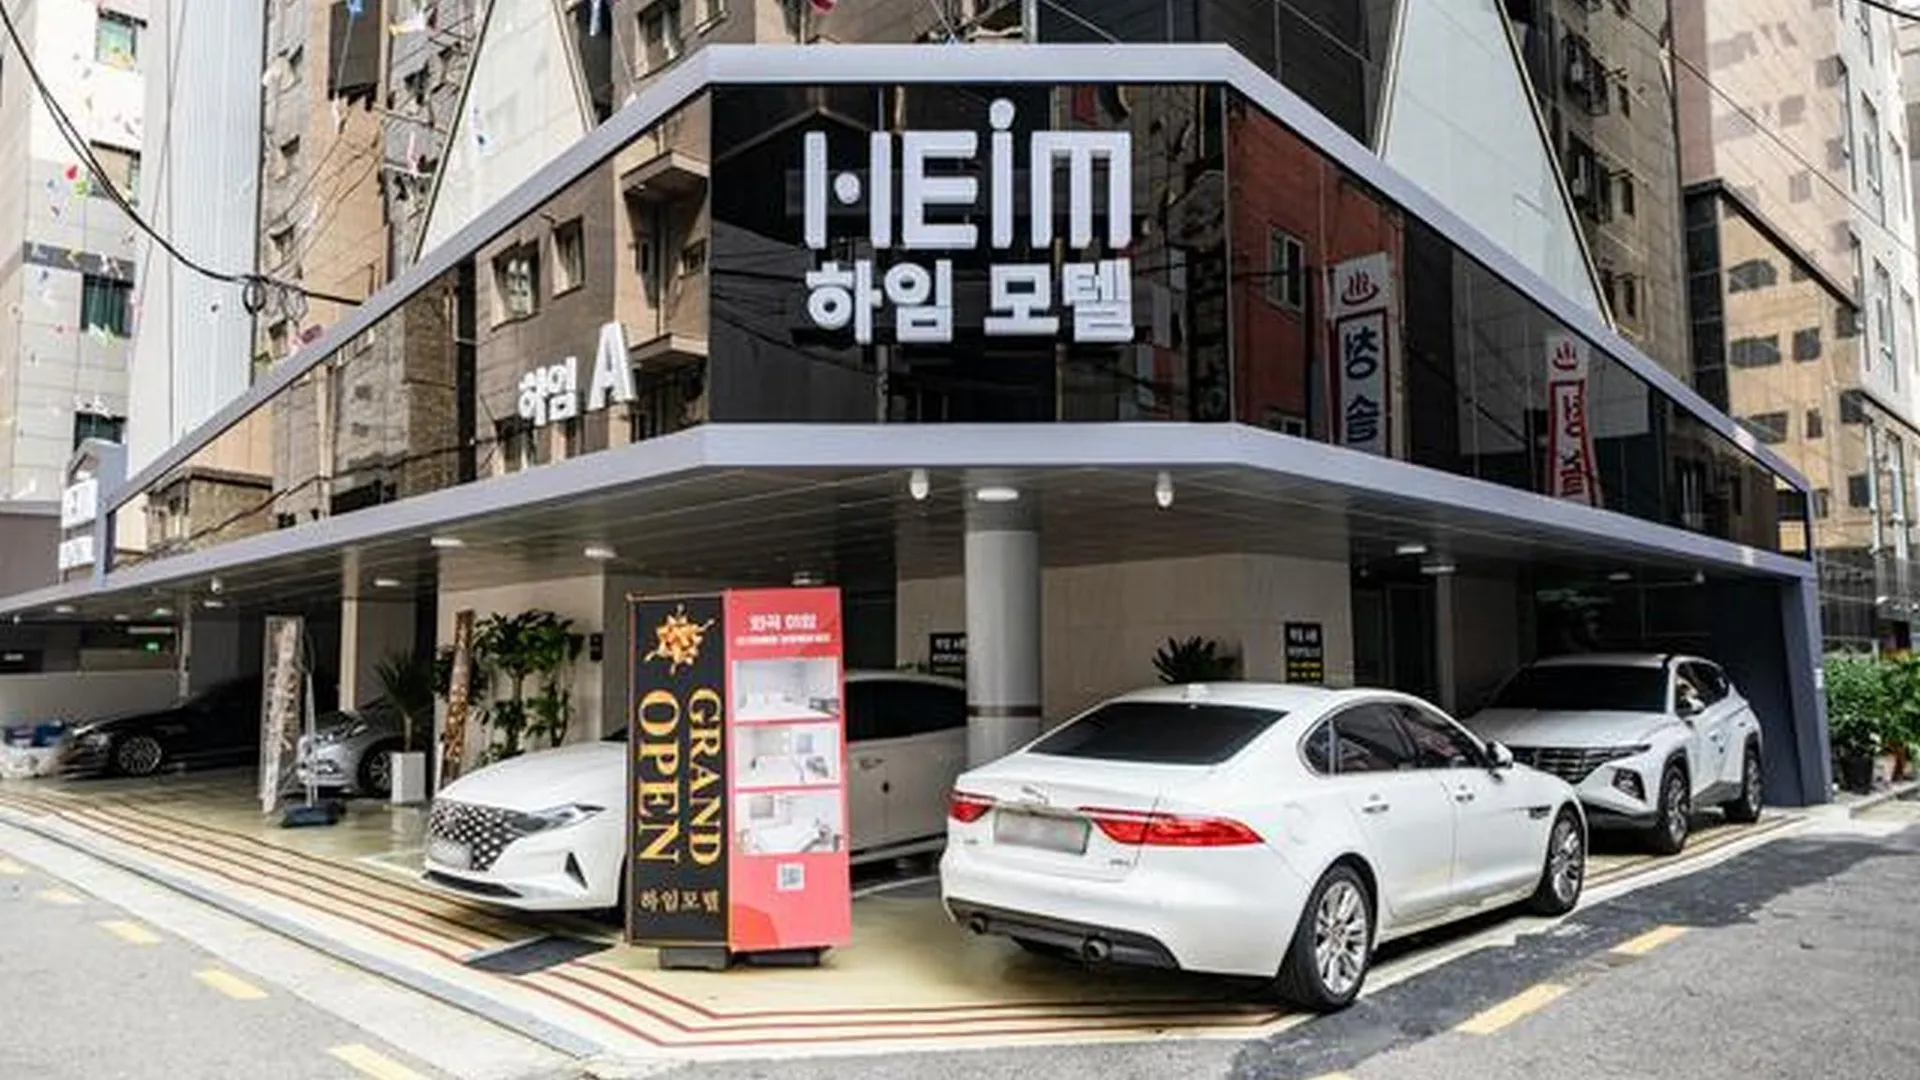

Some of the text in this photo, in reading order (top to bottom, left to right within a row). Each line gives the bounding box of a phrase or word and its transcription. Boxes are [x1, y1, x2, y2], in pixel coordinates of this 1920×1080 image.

[806, 258, 1134, 344] 하임 모텔
[518, 320, 637, 426] 하임 A
[638, 689, 680, 864] OPEN
[688, 688, 721, 866] GRAND
